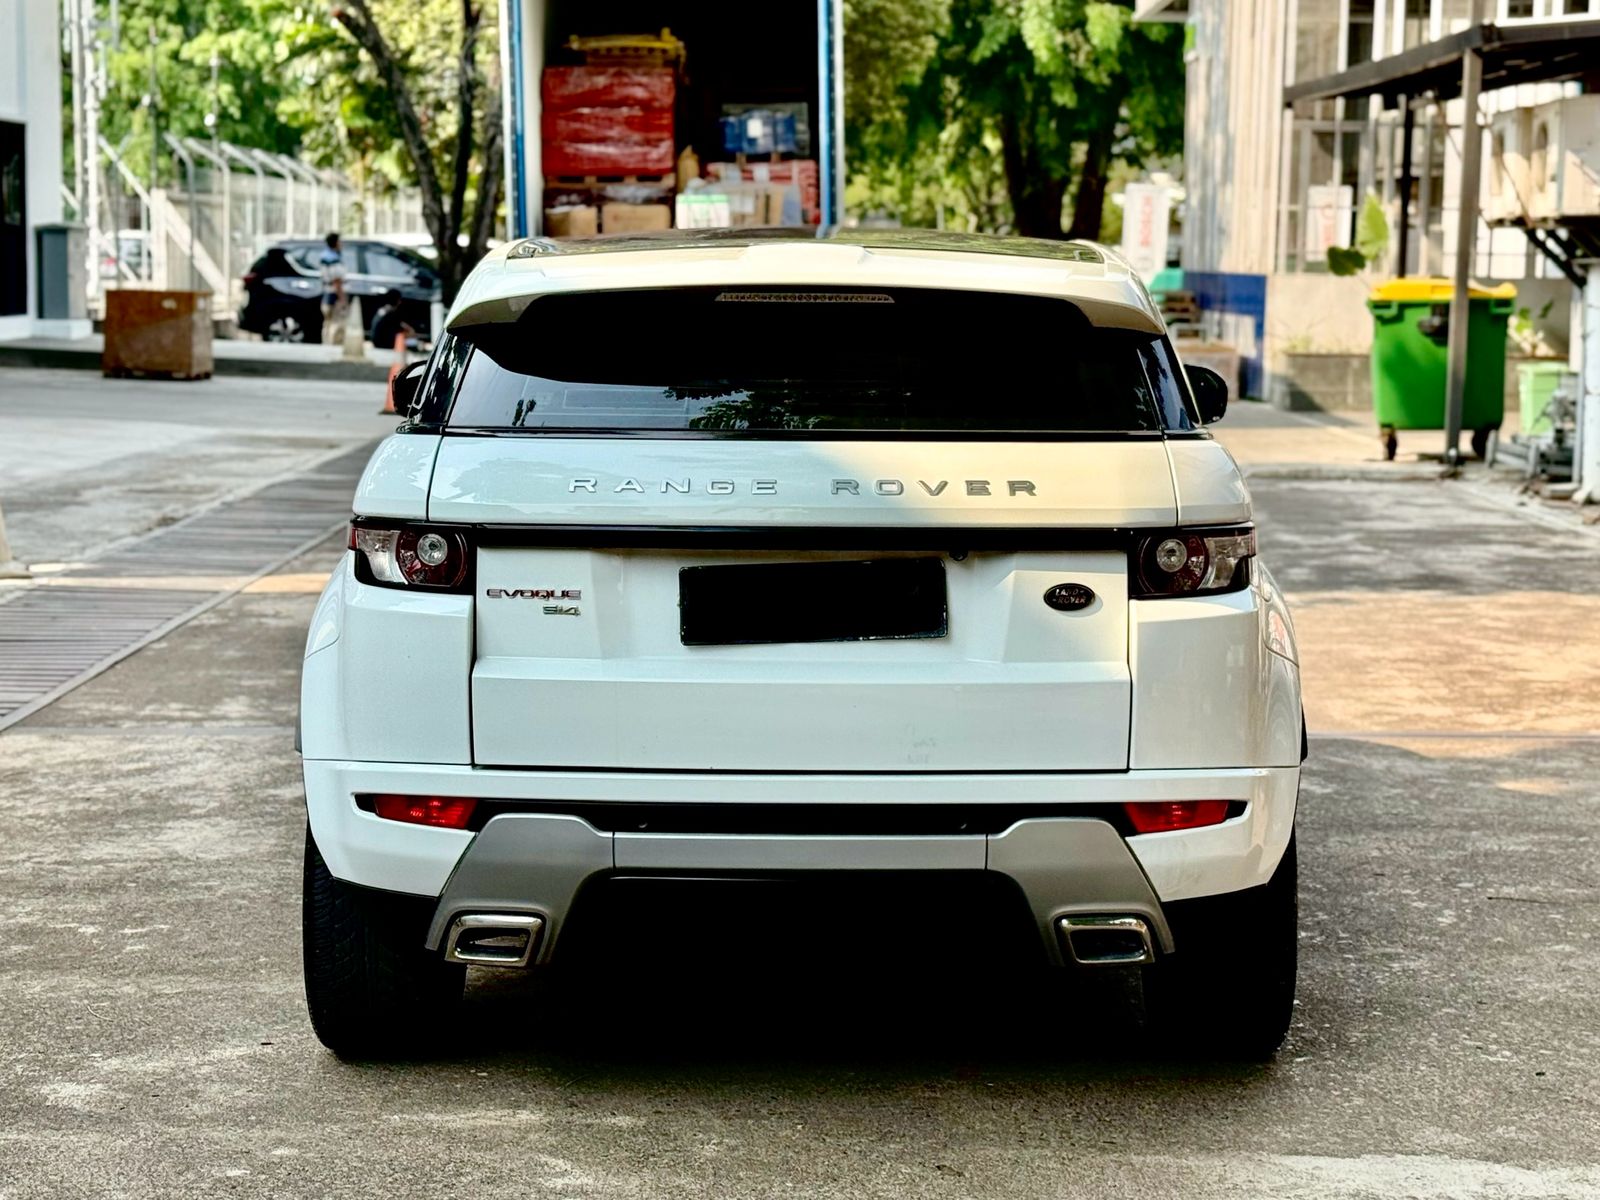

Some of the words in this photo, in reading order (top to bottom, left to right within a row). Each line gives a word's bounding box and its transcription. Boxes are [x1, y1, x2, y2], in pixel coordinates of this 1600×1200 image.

[567, 477, 778, 496] RANGE
[831, 478, 1038, 496] ROVER
[486, 588, 581, 601] EVOQUE
